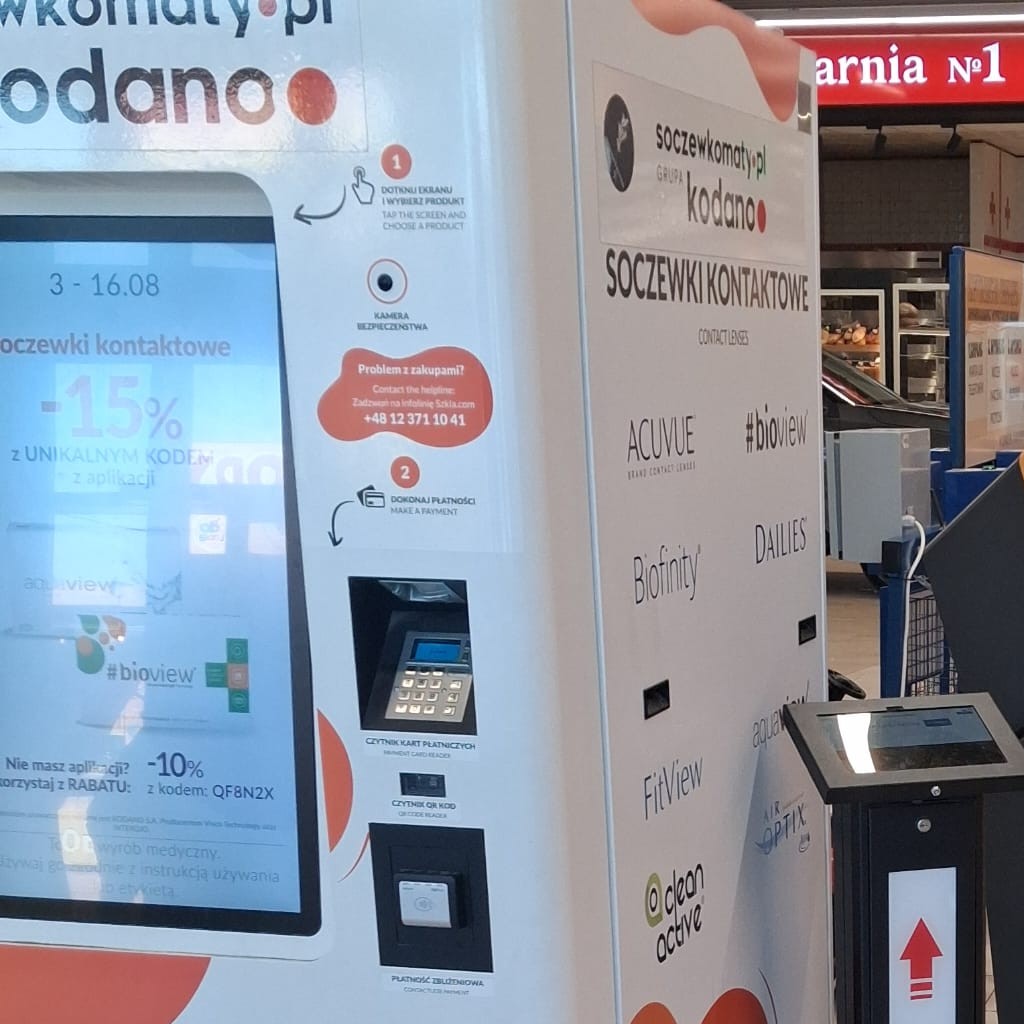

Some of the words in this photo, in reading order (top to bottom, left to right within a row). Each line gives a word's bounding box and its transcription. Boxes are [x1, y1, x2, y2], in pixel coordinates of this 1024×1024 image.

[392, 154, 401, 170] 1
[657, 164, 683, 185] GRUPA
[418, 186, 453, 194] EKRANU
[425, 198, 464, 206] PRODUKT
[687, 171, 755, 232] kodano
[449, 211, 466, 219] AND
[425, 222, 464, 230] PRODUCT
[92, 273, 160, 297] 16.08
[606, 248, 703, 304] SOCZEWKI
[708, 262, 809, 312] KONTAKTOWE
[374, 312, 409, 320] KAMERA
[0, 332, 89, 355] oczewki
[96, 333, 231, 357] kontaktowe
[699, 328, 727, 346] CONTACT
[727, 329, 749, 346] LENSES
[358, 363, 401, 375] Problem
[411, 364, 465, 377] zakupami?
[372, 384, 404, 394] Contact
[406, 385, 419, 394] the
[364, 413, 387, 425] +48
[391, 413, 404, 425] 12
[407, 413, 429, 426] 371
[433, 414, 448, 426] 10
[450, 414, 466, 426] 41
[746, 403, 807, 454] #bioview
[628, 415, 695, 463] ACUVUE
[25, 445, 138, 464] UNIKALNYM
[401, 466, 410, 479] 2
[649, 464, 674, 477] CONTACT
[391, 496, 430, 504] DOKONAJ
[391, 507, 414, 515] MAKE
[422, 508, 458, 516] PAYMENT
[755, 517, 806, 565] DAILIES
[633, 544, 699, 605] Biofinity
[107, 661, 195, 683] #bioview
[5, 757, 29, 770] Nie
[32, 761, 65, 772] masz
[147, 751, 204, 778] -10%
[58, 780, 65, 790] z
[68, 777, 131, 793] RABATU:
[147, 784, 154, 794] z
[159, 782, 208, 797] kodem:
[212, 784, 275, 801] QF8N2X
[644, 757, 703, 821] FitView
[764, 801, 780, 823] AIR
[757, 803, 806, 855] OPTIX
[665, 863, 704, 915] clean
[657, 904, 702, 963] active
